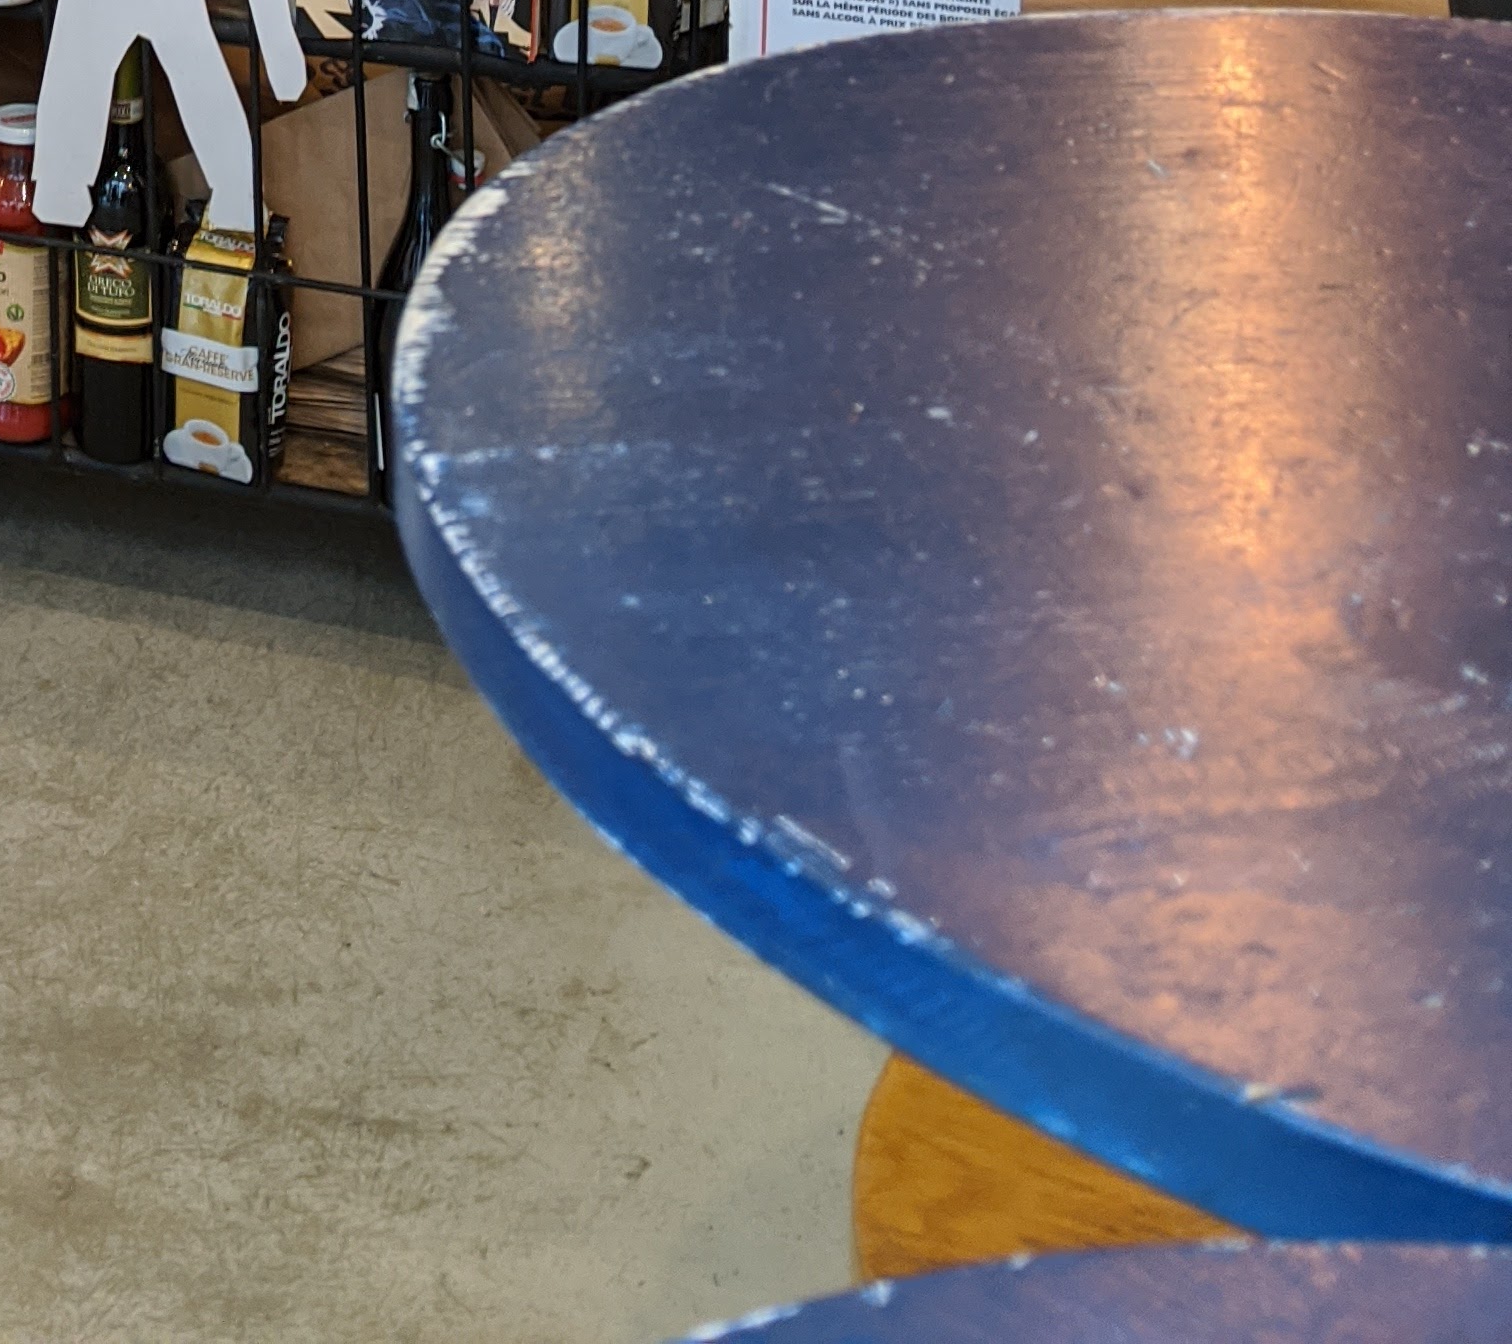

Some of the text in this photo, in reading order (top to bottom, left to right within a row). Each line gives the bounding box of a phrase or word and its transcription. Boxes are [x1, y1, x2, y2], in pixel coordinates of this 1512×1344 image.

[792, 8, 820, 18] SANS
[823, 12, 865, 24] ALCOOL
[880, 18, 906, 28] PRIX
[816, 0, 830, 8] LA
[868, 5, 913, 18] PÉRIODE
[917, 11, 936, 21] DES
[903, 0, 931, 10] SANS
[934, 2, 991, 17] PROPOSER
[184, 292, 242, 315] TORALDO
[271, 312, 291, 425] TORALDO
